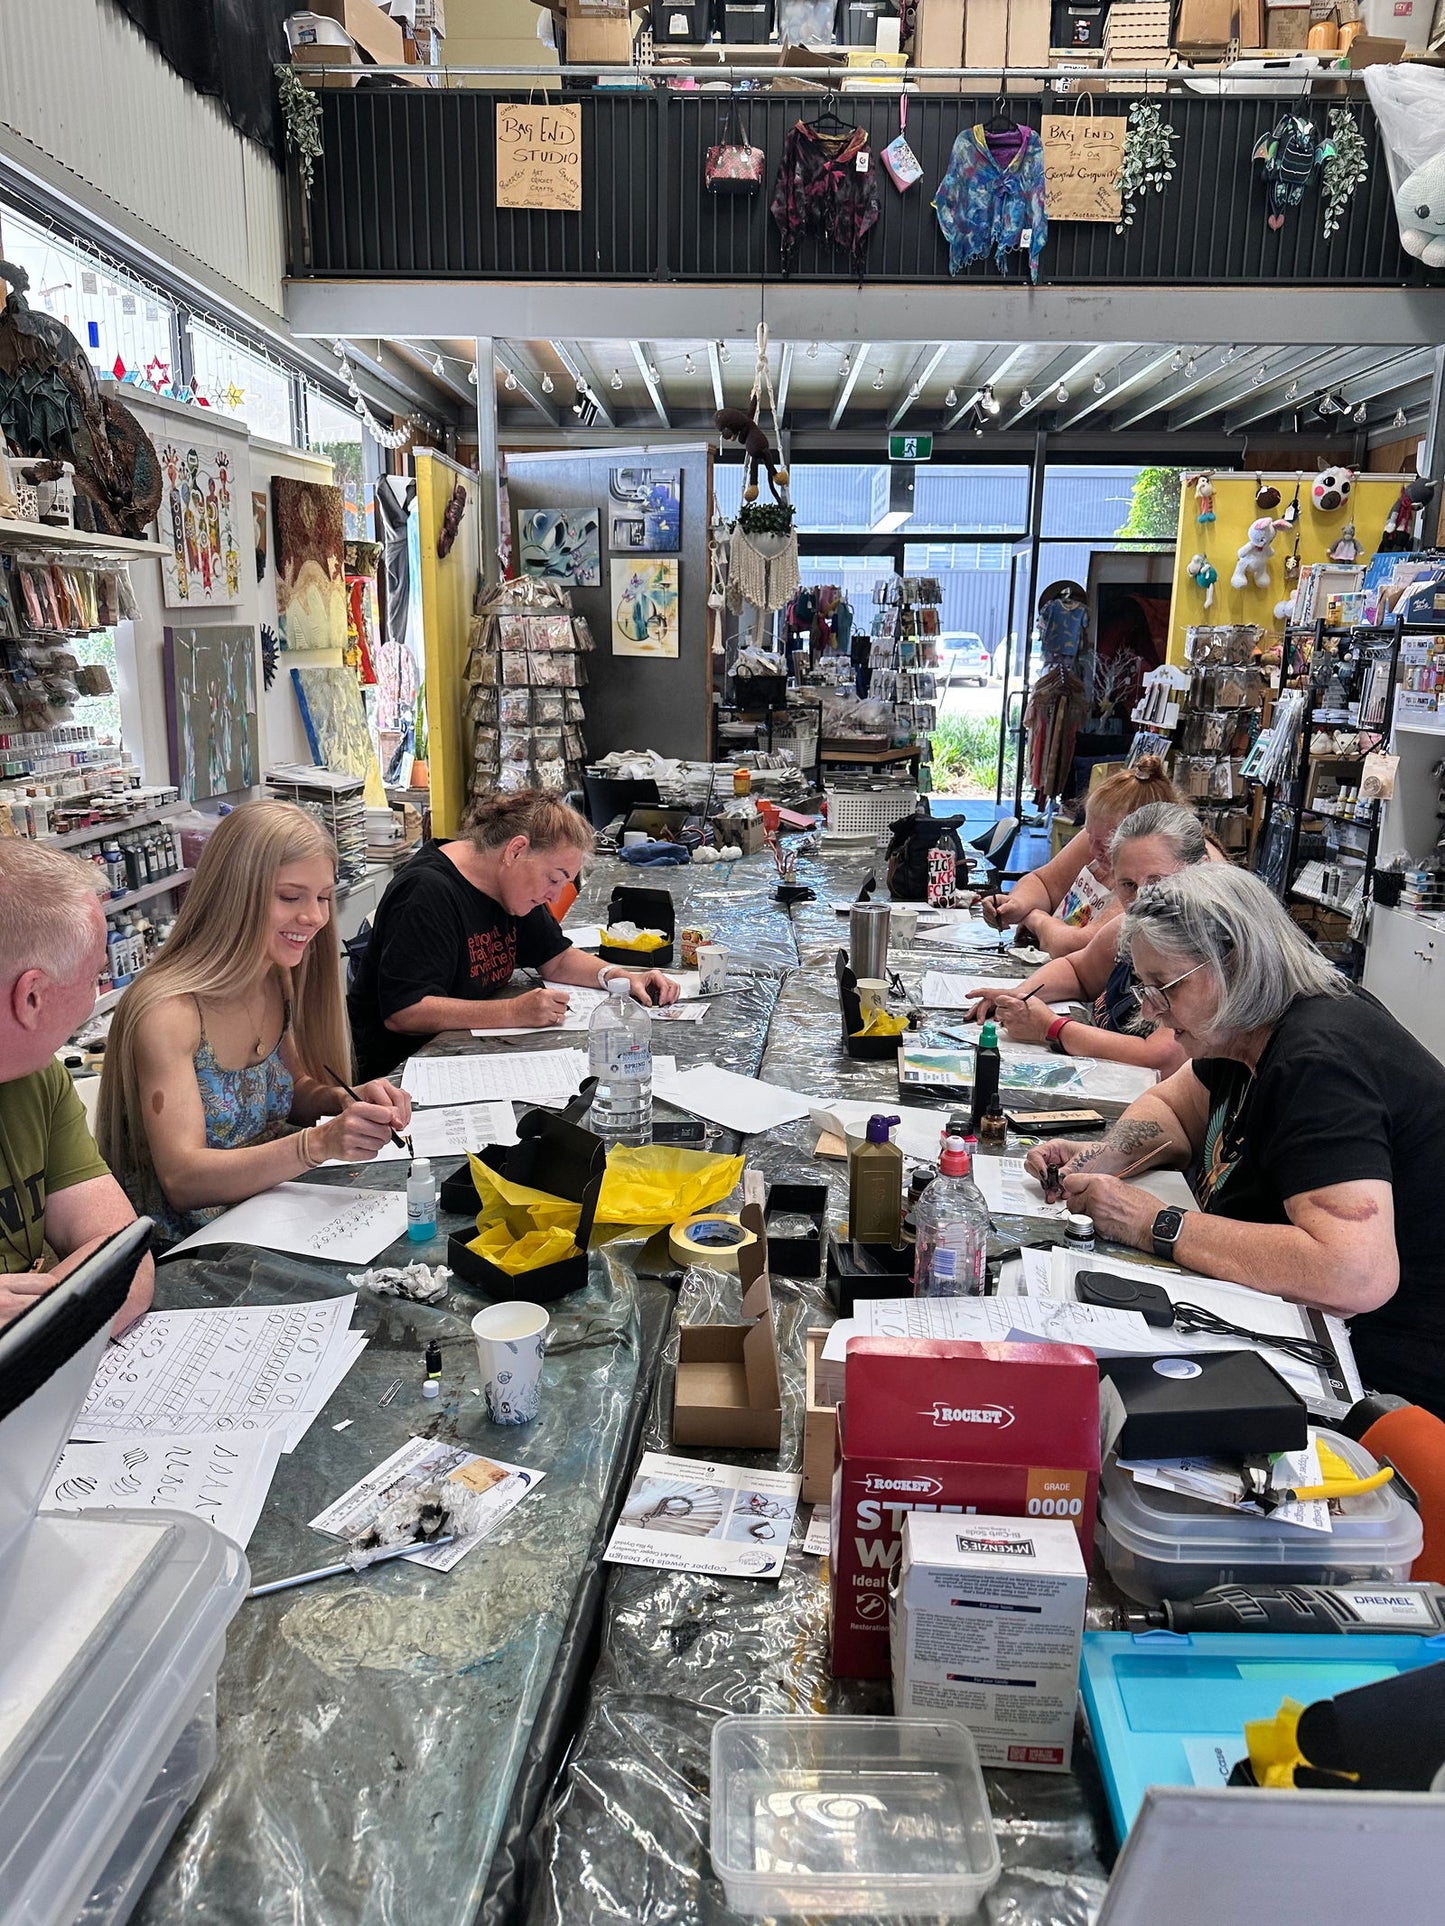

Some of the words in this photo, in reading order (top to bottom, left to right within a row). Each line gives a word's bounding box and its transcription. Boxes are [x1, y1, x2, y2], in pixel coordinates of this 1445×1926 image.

[499, 117, 533, 143] BAG
[540, 116, 576, 145] END
[1049, 125, 1075, 142] BAG
[1084, 127, 1114, 140] END
[512, 148, 579, 165] STUDIO
[942, 1408, 1002, 1424] ROCKET
[874, 1478, 932, 1492] ROCKET
[1044, 1483, 1070, 1491] GRADE
[1028, 1498, 1082, 1516] 0000
[608, 1552, 641, 1563] Design
[643, 1557, 655, 1565] by
[657, 1559, 690, 1569] Jewels
[691, 1563, 727, 1573] Copper
[852, 1574, 885, 1588] Ideal
[1353, 1596, 1414, 1606] DREMEL
[851, 1622, 890, 1632] Restoration
[1214, 1747, 1229, 1776] Case
